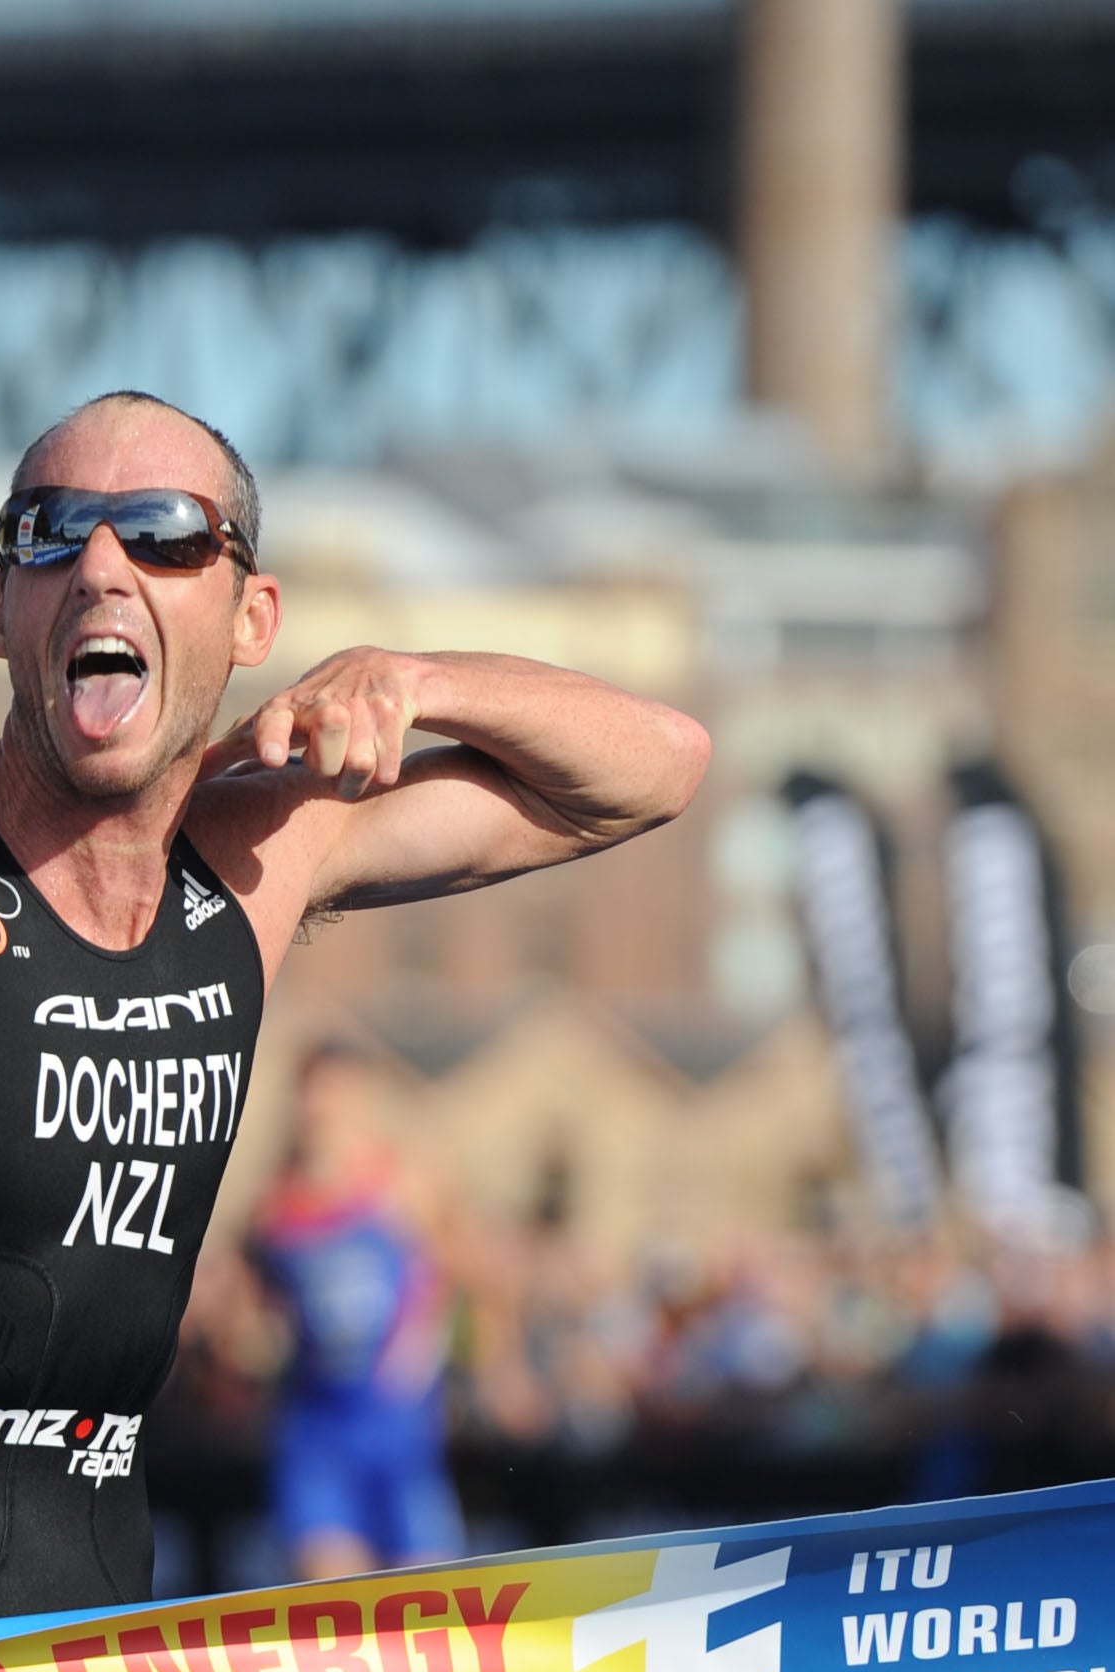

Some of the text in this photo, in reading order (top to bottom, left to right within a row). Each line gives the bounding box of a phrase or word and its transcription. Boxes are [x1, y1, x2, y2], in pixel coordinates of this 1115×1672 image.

[185, 894, 227, 931] adidas
[12, 945, 31, 959] ITU
[34, 1051, 242, 1147] DOCHERTY
[61, 1159, 176, 1255] NZL
[67, 1449, 135, 1489] rapid
[847, 1544, 954, 1594] ITU
[841, 1597, 1078, 1666] WORLD
